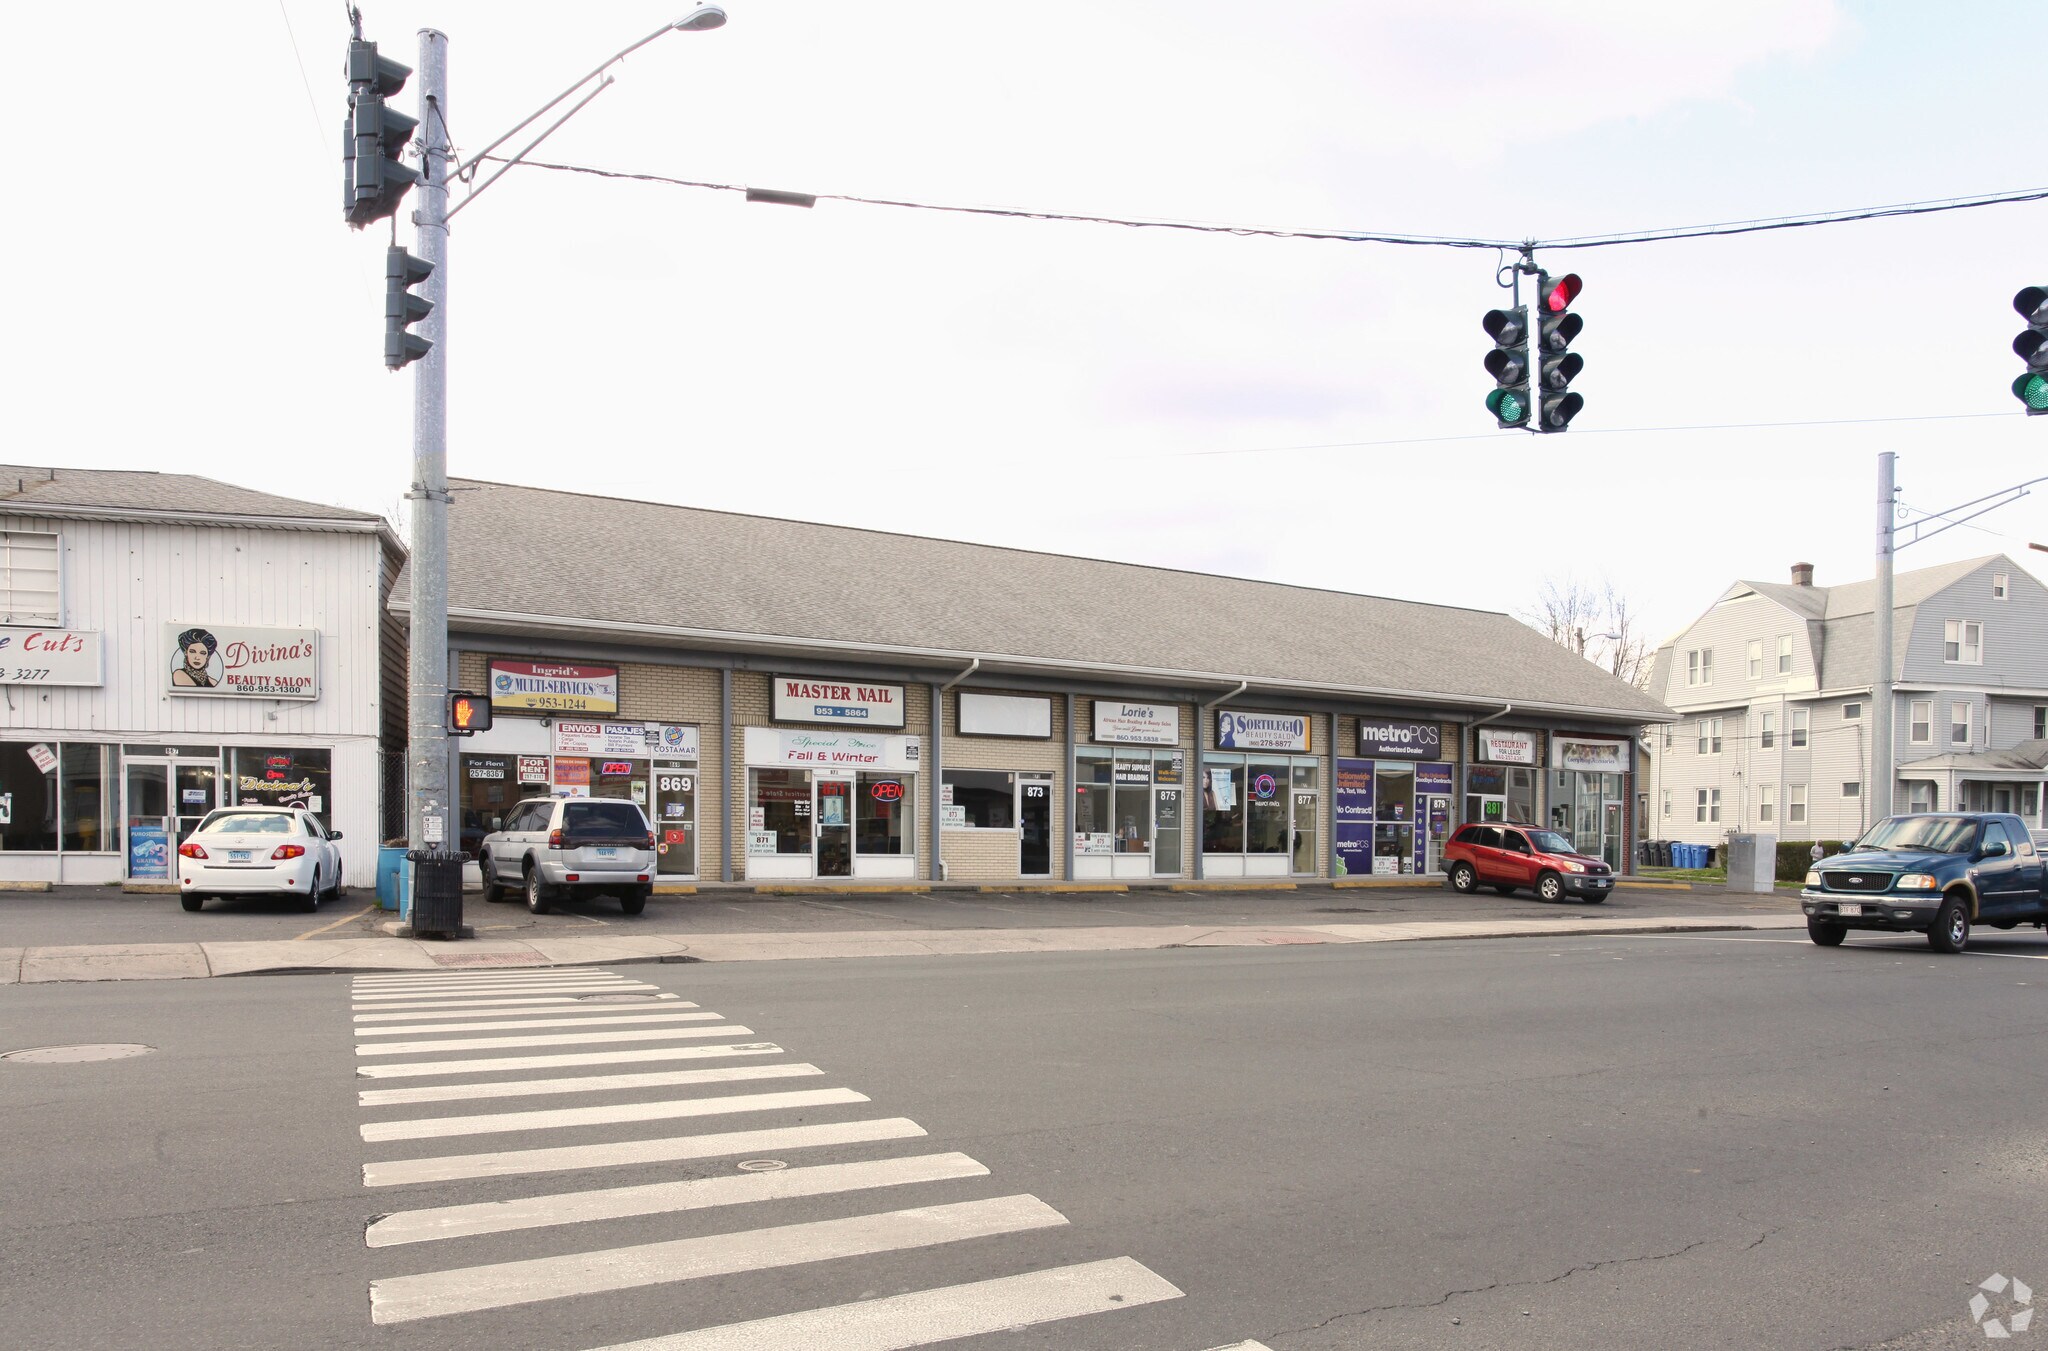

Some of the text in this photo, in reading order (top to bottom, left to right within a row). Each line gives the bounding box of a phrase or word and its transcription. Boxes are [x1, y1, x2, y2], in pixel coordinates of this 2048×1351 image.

[23, 632, 84, 652] Cuts
[225, 638, 312, 669] Divina's
[531, 664, 579, 677] Ingrid's
[227, 674, 311, 688] BEAUTY SALON
[514, 677, 594, 696] MULTI-SERVICES
[236, 685, 301, 694] 860-953-1300
[786, 682, 893, 703] MASTER NAIL
[539, 697, 586, 709] 953-1244
[816, 707, 833, 715] 953
[845, 708, 867, 717] 5864
[1121, 704, 1154, 718] Lorie's
[562, 724, 598, 733] ENVIOS
[606, 726, 645, 735] PASAJES
[1236, 715, 1304, 737] SORTILEGIO
[1245, 731, 1272, 739] BEAUTY
[1363, 724, 1437, 744] metroPCS
[792, 736, 840, 748] Special
[1260, 739, 1292, 748] 278-8877
[1490, 740, 1528, 749] RESTAURANT
[654, 745, 696, 753] COSTAMAR
[1379, 745, 1424, 754] Authorized Dealer
[787, 750, 879, 763] Fall & Winter
[470, 769, 504, 779] 257-8367
[604, 763, 630, 773] OPEN
[240, 777, 316, 791] Divina's
[660, 777, 692, 791] 869
[823, 782, 845, 796] 871
[871, 783, 905, 798] OPEN
[1027, 786, 1044, 797] 873
[1160, 791, 1176, 800] 875
[1297, 795, 1311, 804] 877
[1433, 799, 1446, 808] 879
[1486, 801, 1500, 814] 881
[1337, 840, 1369, 848] metroPCS
